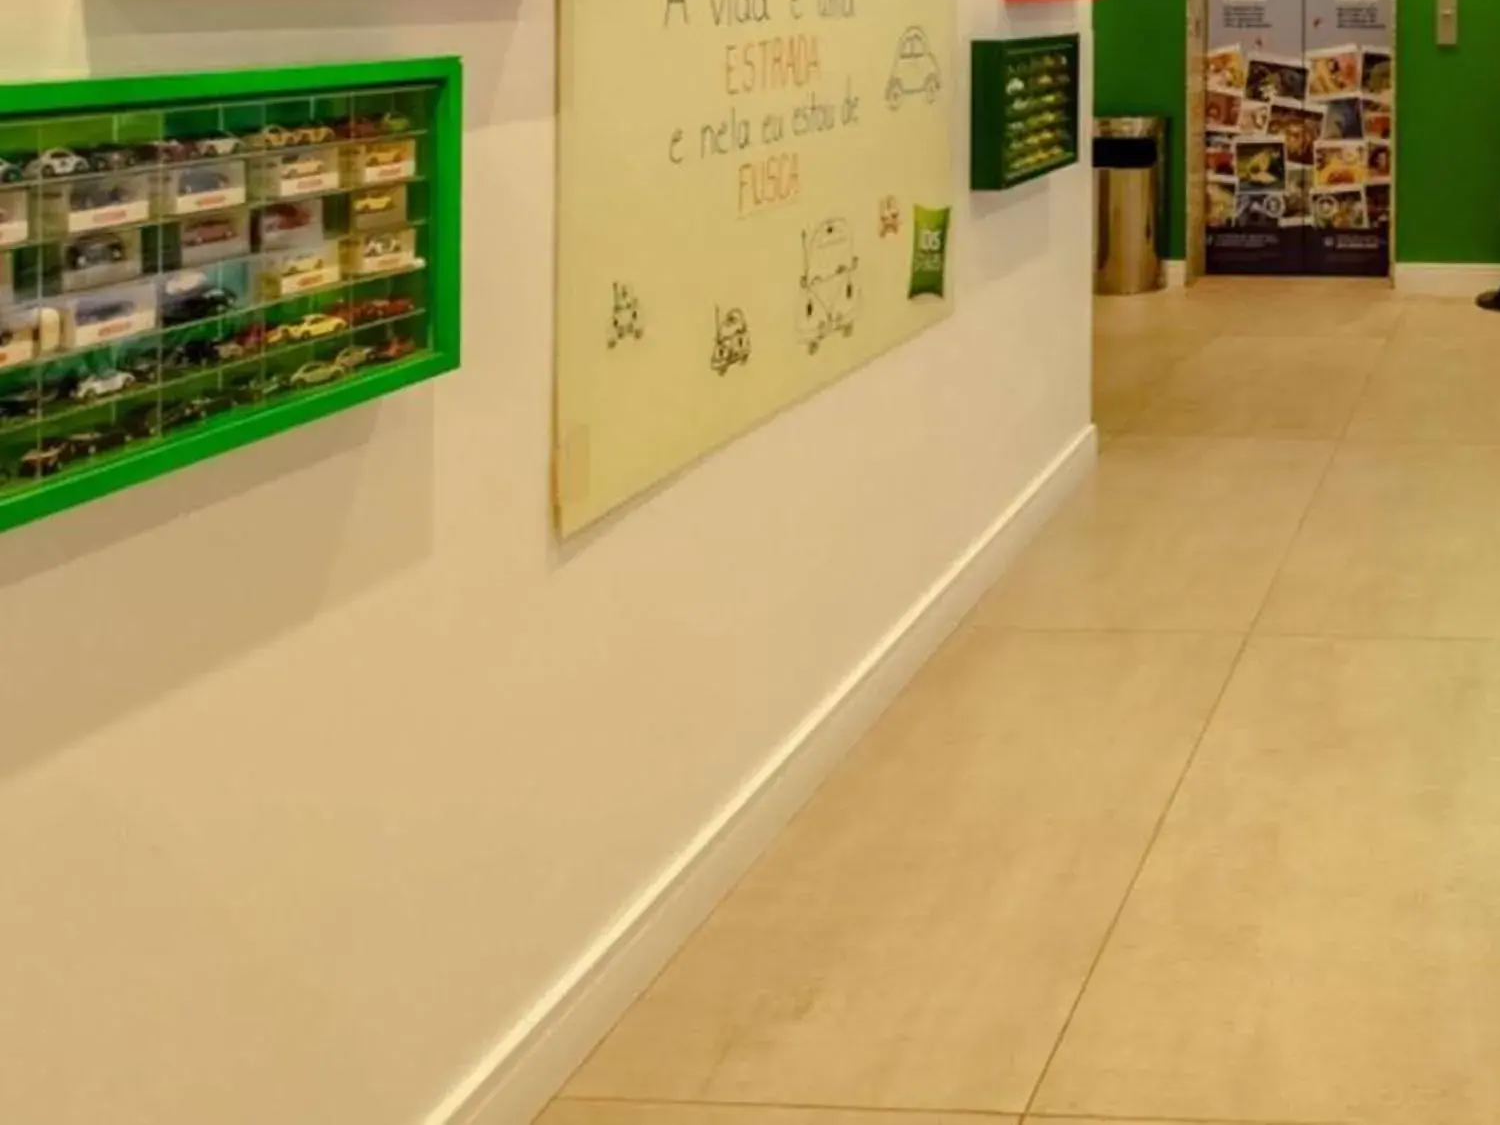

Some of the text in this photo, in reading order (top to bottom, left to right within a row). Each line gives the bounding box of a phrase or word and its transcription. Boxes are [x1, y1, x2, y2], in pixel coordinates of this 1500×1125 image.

[725, 33, 822, 95] ESTRADA
[668, 128, 686, 165] e
[699, 106, 752, 159] nela
[760, 113, 785, 144] eu
[841, 75, 861, 127] de
[738, 152, 802, 214] FUSCA
